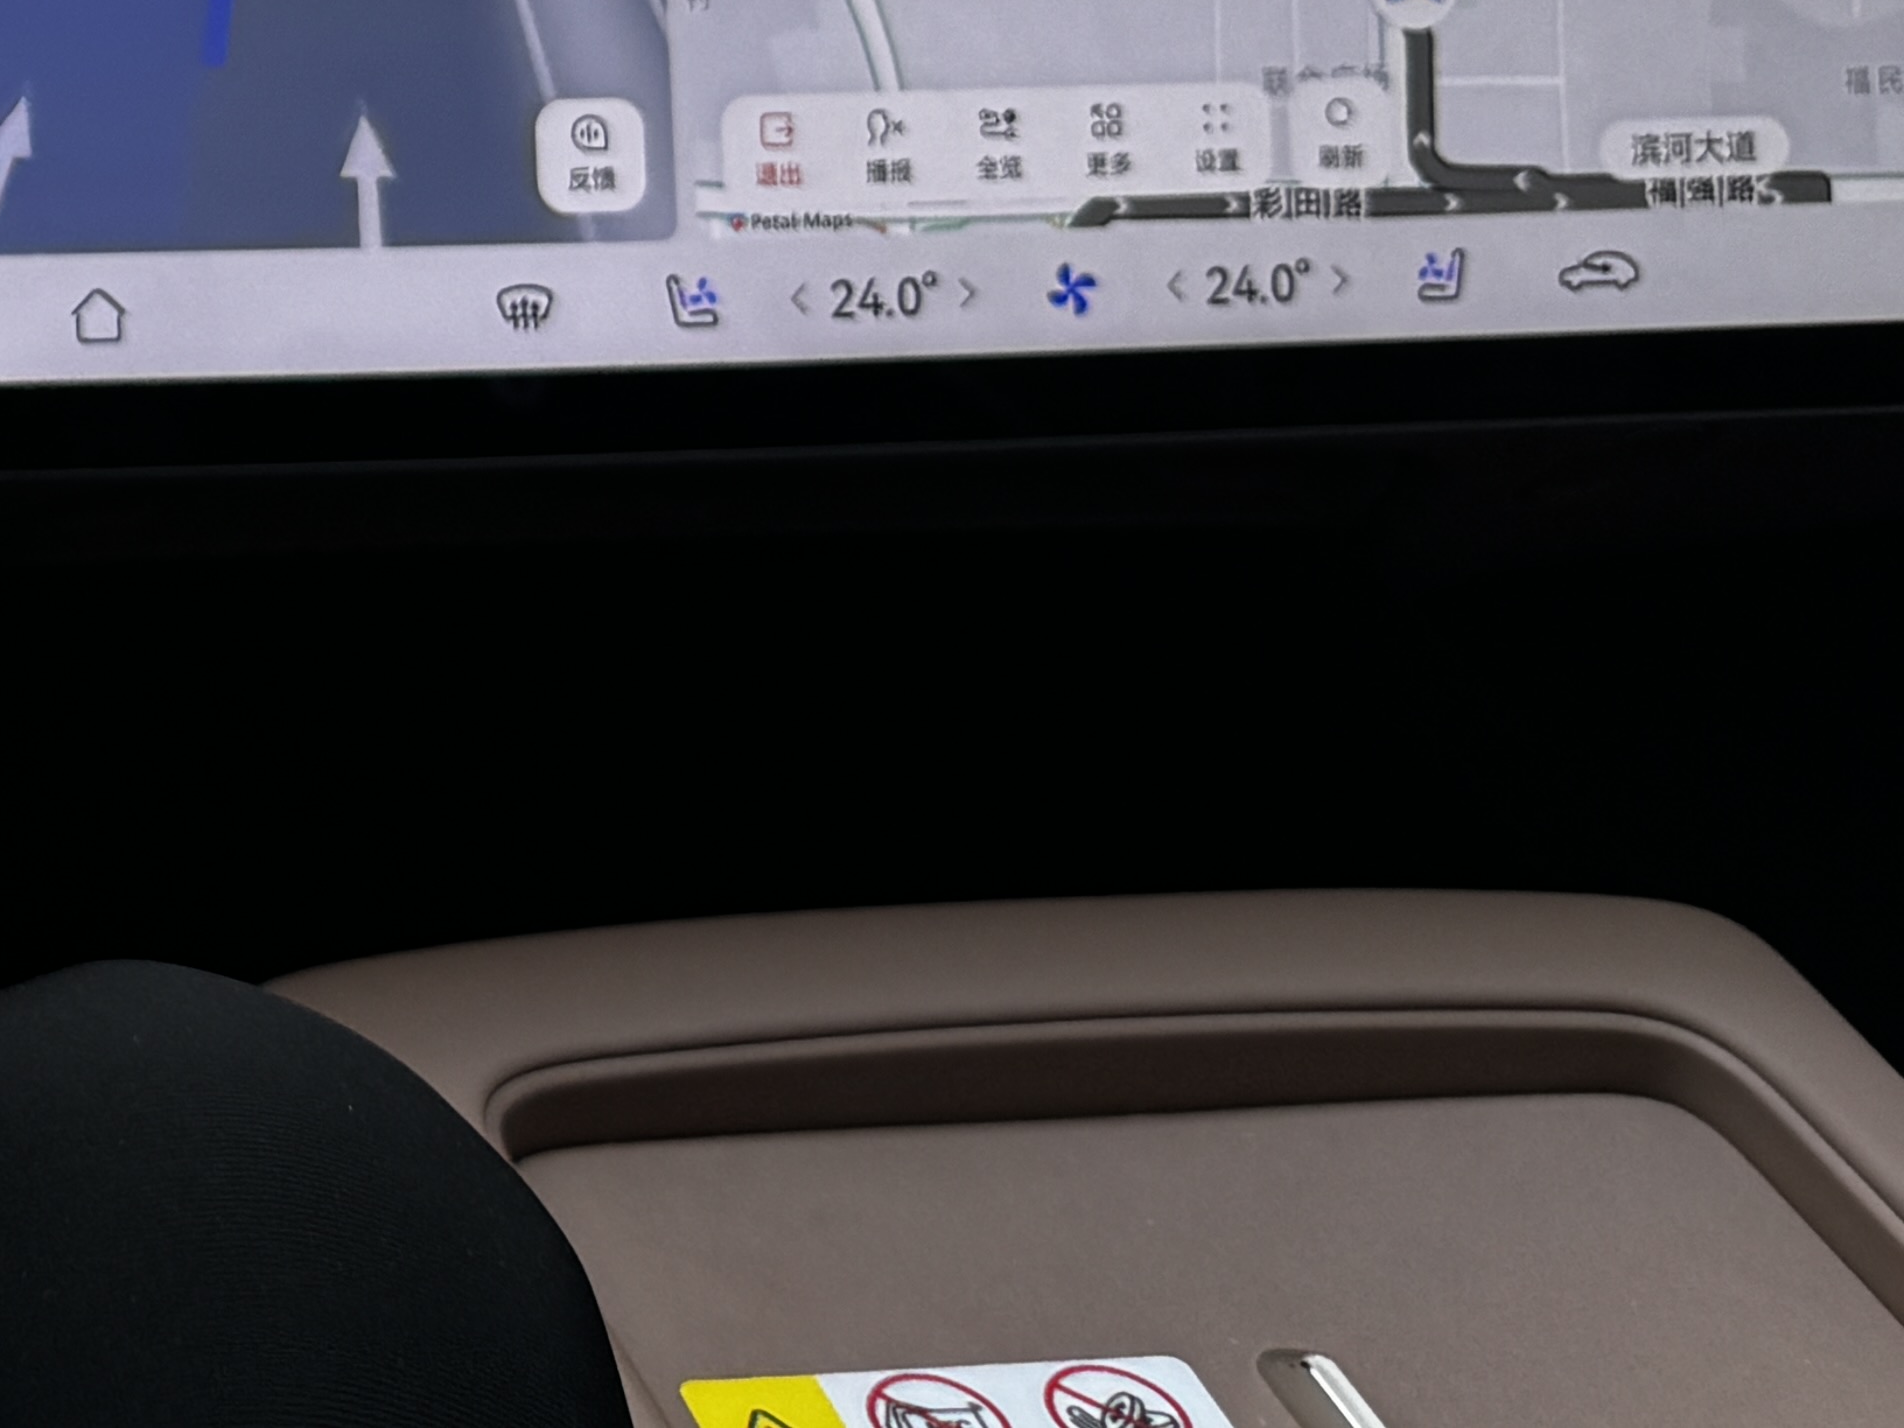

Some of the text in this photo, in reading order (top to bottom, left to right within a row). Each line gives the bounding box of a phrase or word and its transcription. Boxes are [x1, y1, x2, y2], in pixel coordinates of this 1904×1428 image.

[1631, 130, 1757, 166] 滨河大道
[976, 154, 1024, 181] 全览
[1087, 151, 1133, 178] 更多
[568, 166, 617, 194] 反馈
[804, 211, 852, 231] Maps
[830, 269, 939, 319] 24.0°
[1205, 257, 1313, 307] 24.0°
